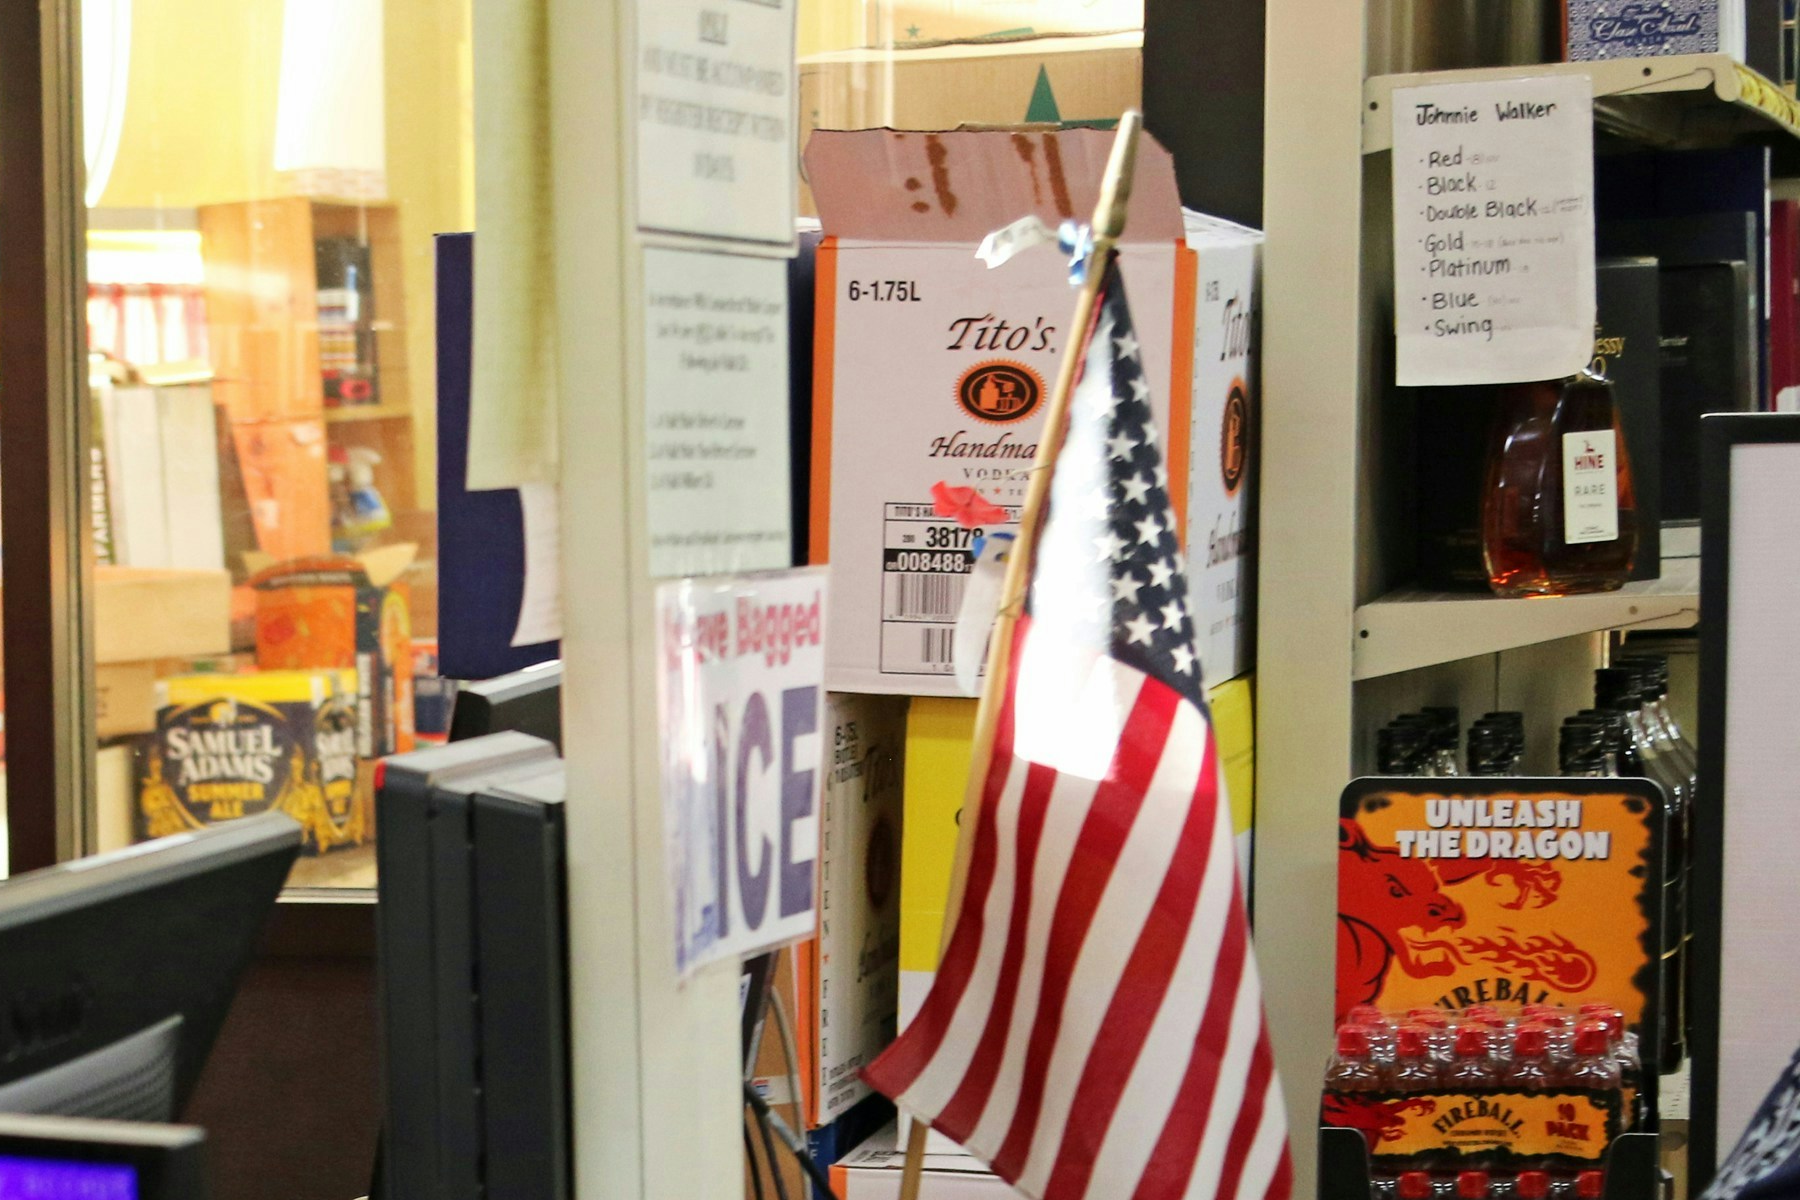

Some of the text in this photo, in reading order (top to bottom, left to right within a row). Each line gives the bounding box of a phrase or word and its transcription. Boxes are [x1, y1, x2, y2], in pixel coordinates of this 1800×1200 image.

[1416, 100, 1558, 126] Johnnie Walker
[1428, 145, 1463, 169] Red
[1427, 172, 1477, 196] Black
[1426, 196, 1538, 222] Double Black
[1424, 230, 1465, 258] Gold
[1429, 257, 1512, 278] Platinum
[849, 280, 921, 302] 6-1.75L
[1432, 292, 1480, 310] Blue
[946, 312, 1056, 352] Tito's
[1434, 314, 1494, 342] Swing
[928, 429, 1038, 460] Handma
[1574, 454, 1605, 470] HINE
[736, 590, 821, 667] Bagged
[166, 724, 283, 760] SAMUEL
[178, 753, 275, 787] ADAMS
[715, 684, 818, 940] ICE
[1426, 799, 1582, 829] UNLEASH
[1395, 829, 1611, 861] THE DRAGON
[1434, 977, 1564, 1010] IREBAL
[1431, 1094, 1527, 1139] FIREBALL
